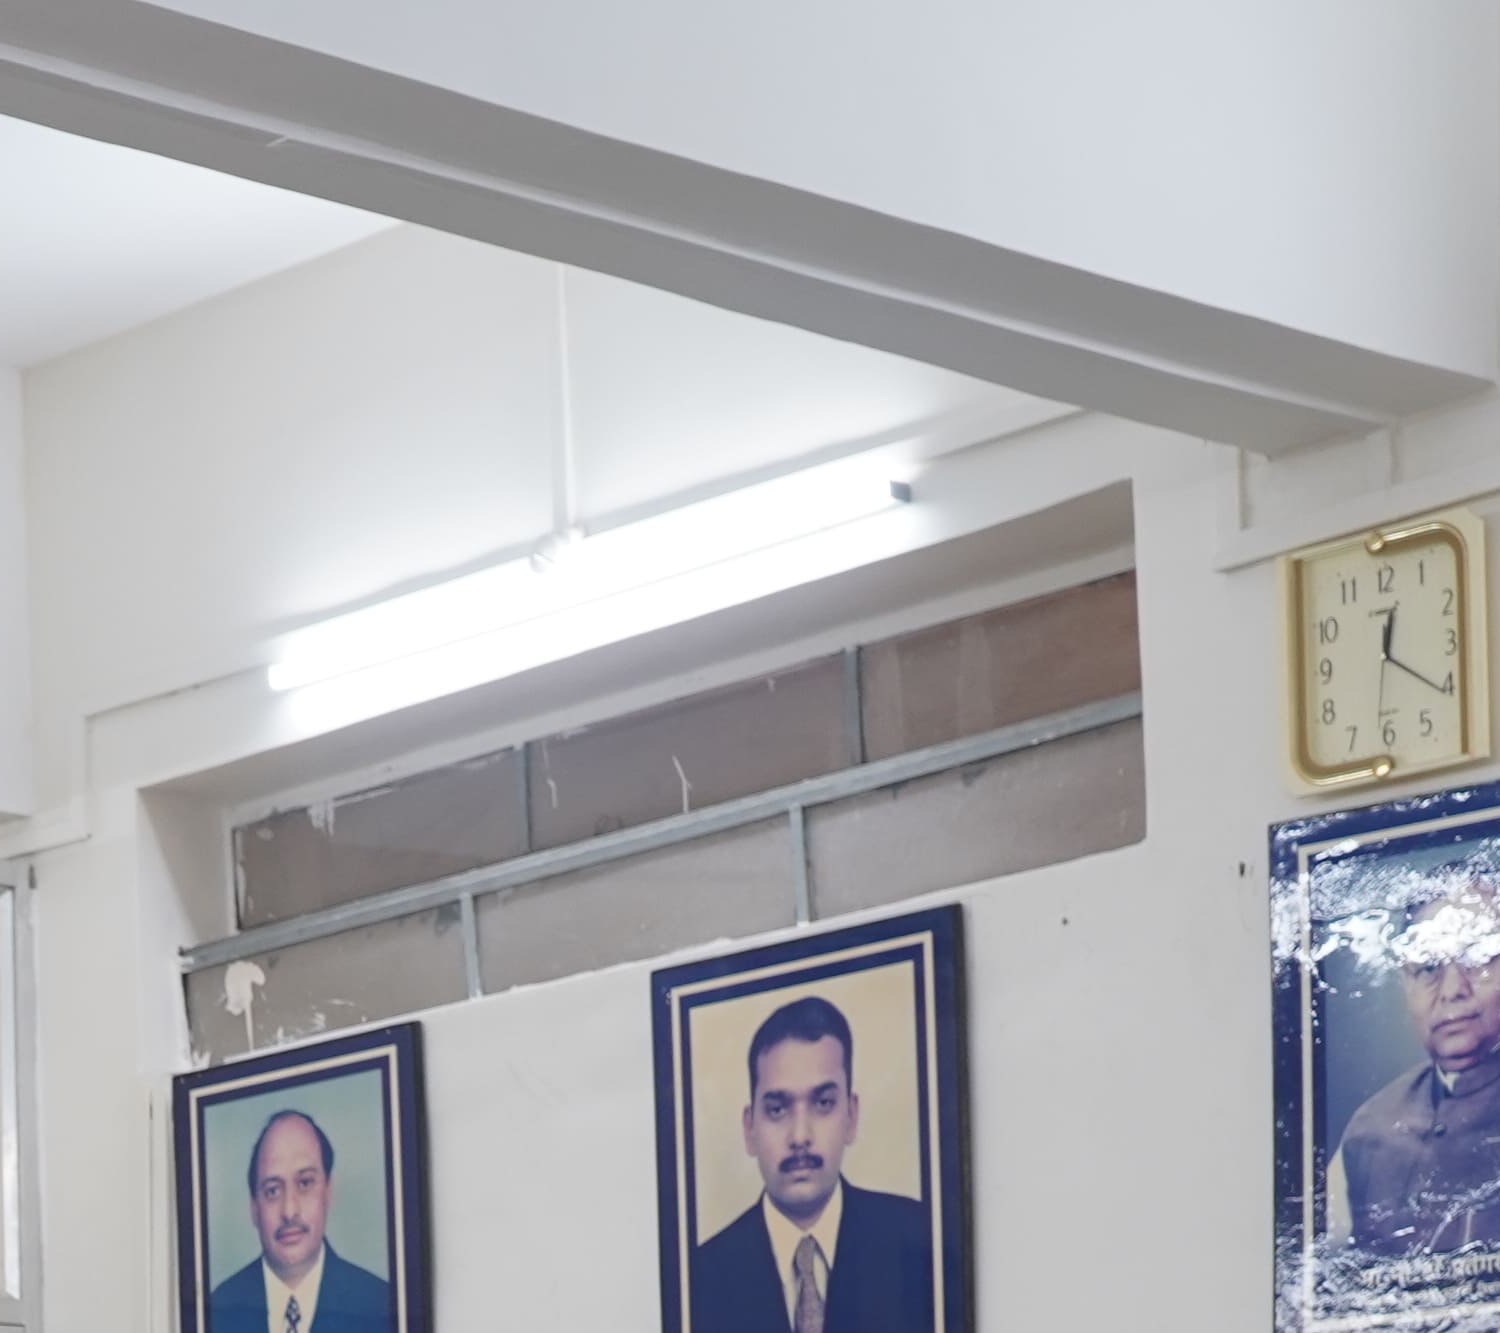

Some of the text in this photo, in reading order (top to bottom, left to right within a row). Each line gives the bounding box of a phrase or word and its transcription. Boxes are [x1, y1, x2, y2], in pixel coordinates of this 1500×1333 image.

[1377, 565, 1394, 594] 12
[1419, 559, 1425, 586] 1
[1341, 576, 1357, 606] 11
[1442, 587, 1454, 617] 2
[1319, 616, 1339, 646] 10
[1445, 628, 1457, 657] 3
[1319, 657, 1333, 686] 9
[1441, 671, 1455, 697] 4
[1321, 698, 1336, 726] 8
[1419, 709, 1433, 738] 5
[1345, 725, 1358, 753] 7
[1382, 720, 1396, 748] 6
